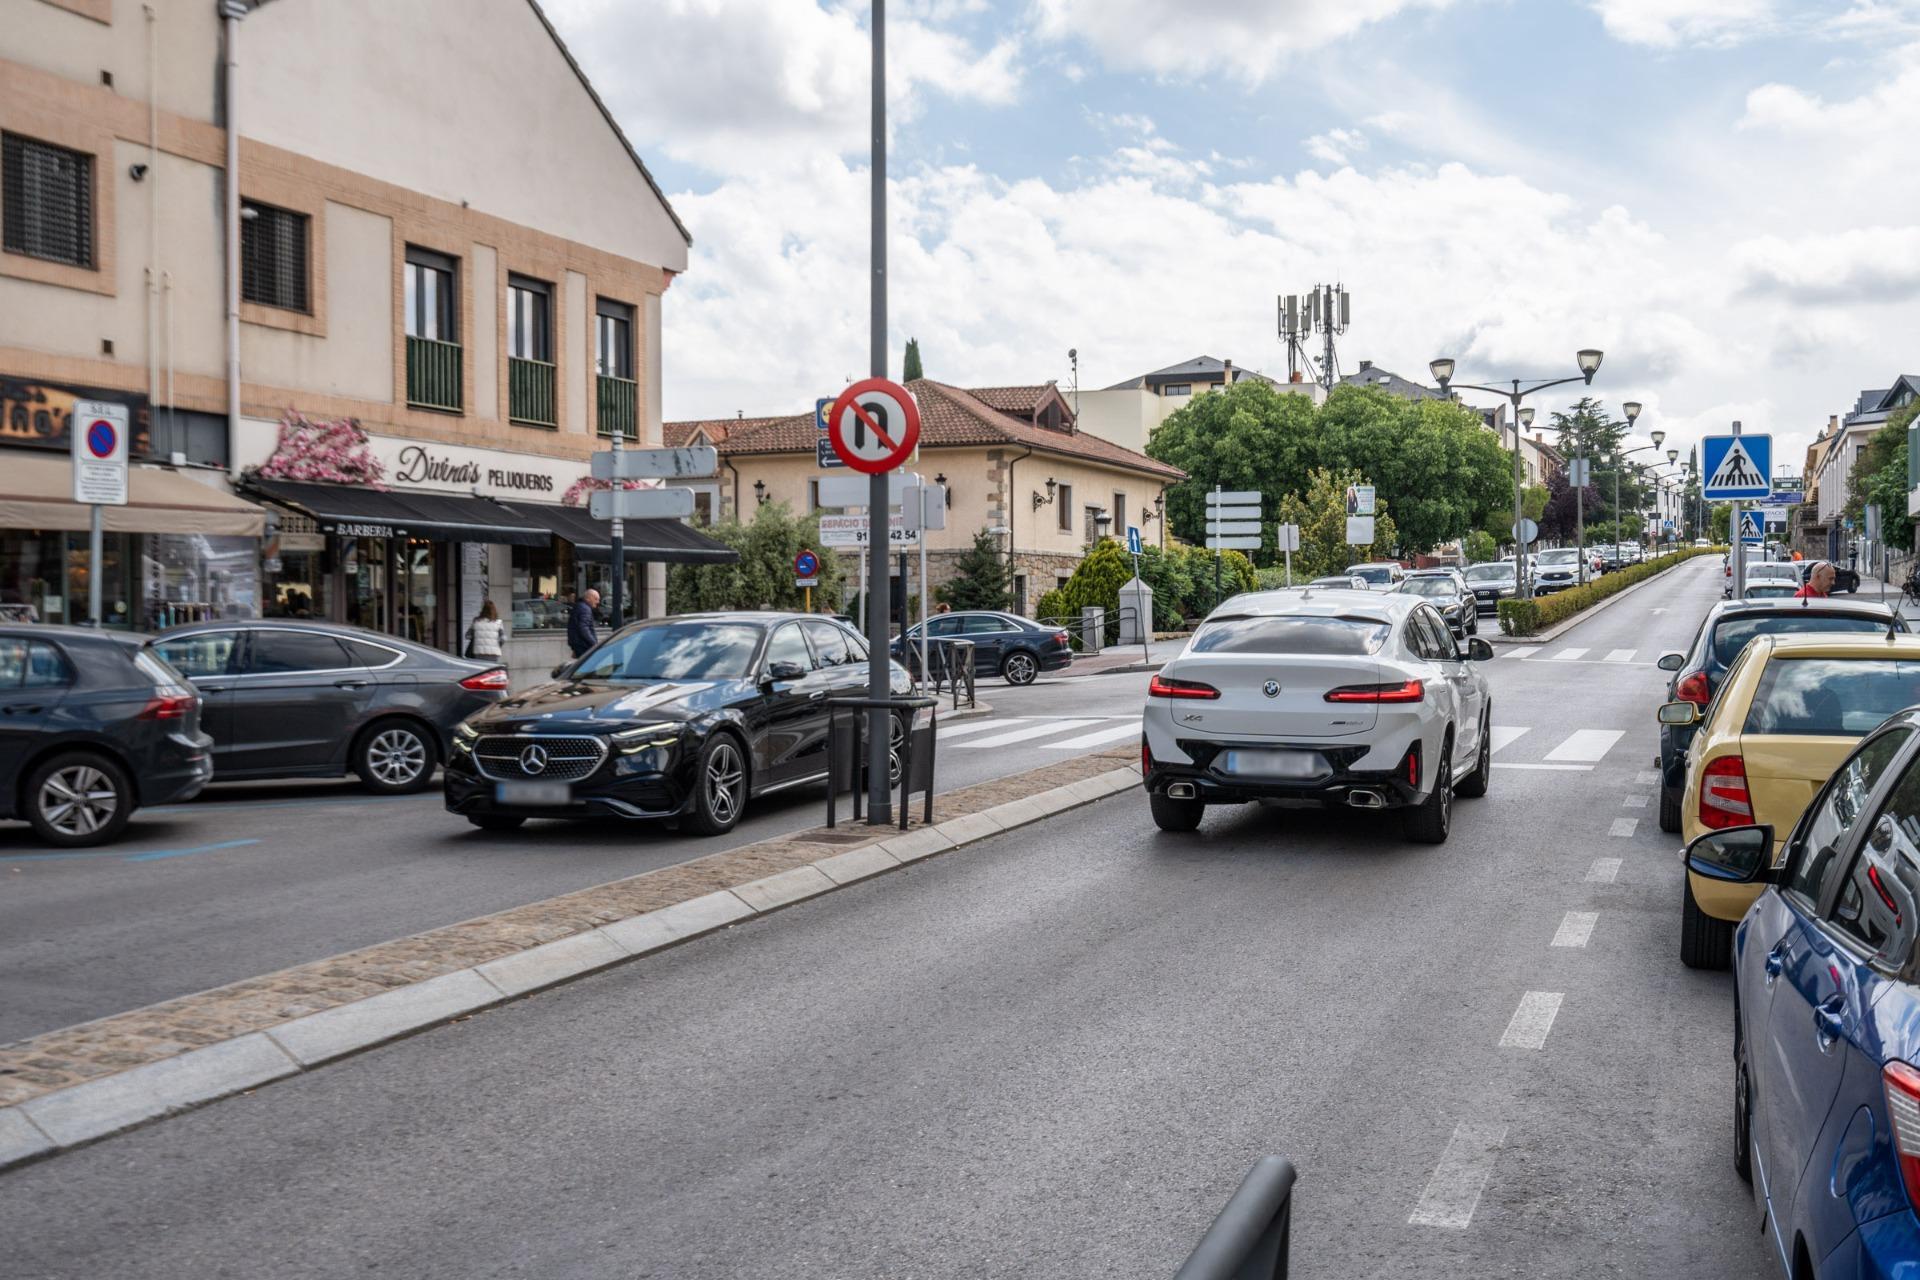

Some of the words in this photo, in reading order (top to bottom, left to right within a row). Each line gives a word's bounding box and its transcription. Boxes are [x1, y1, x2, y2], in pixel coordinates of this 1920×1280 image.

[396, 446, 481, 484] Divina's
[488, 469, 553, 492] PELUQUEROS
[337, 523, 394, 538] BARBERIA
[822, 519, 860, 529] ESPACIO
[856, 532, 867, 541] 91
[890, 530, 902, 540] 42
[905, 530, 917, 540] 54
